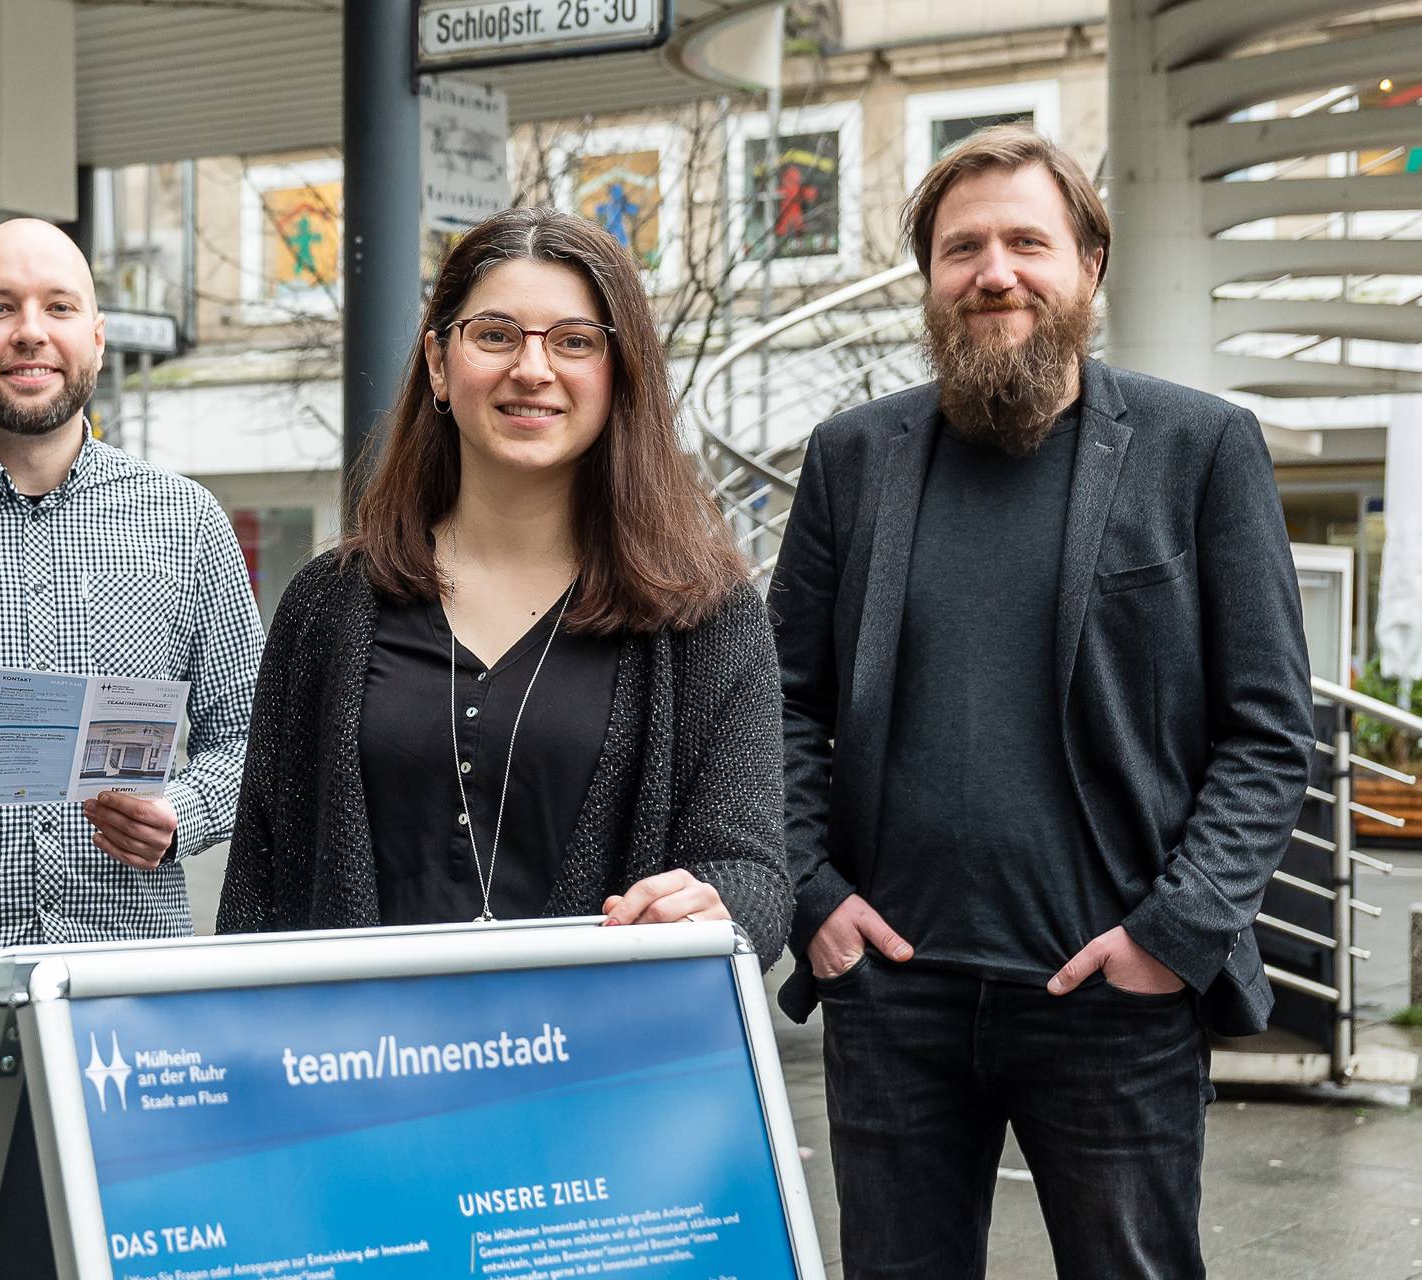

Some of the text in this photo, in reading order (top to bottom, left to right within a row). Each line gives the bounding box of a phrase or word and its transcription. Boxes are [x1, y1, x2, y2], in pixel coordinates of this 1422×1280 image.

[437, 0, 636, 44] Schloßstr. 26-30
[2, 675, 32, 683] KONTAKT
[135, 1048, 201, 1068] Mülheim
[282, 1023, 570, 1085] team/Innenstadt
[138, 1064, 227, 1087] an der Ruhr
[141, 1090, 228, 1110] Stadt am Fluss
[458, 1177, 609, 1216] UNSERE ZIELE
[111, 1222, 227, 1259] DAS TEAM
[476, 1203, 704, 1243] Die Mülheimer Innenstadt ist uns ein großes Anliegen!
[479, 1211, 740, 1258] Gemeinsam mit Ihnen möchten wir die Innenstadt stärken und
[210, 1264, 232, 1278] oder
[233, 1258, 290, 1276] Anregungen
[291, 1257, 307, 1269] zur
[307, 1249, 363, 1266] Entwicklung
[364, 1246, 380, 1259] der
[381, 1240, 429, 1256] Innenstadt
[482, 1258, 532, 1273] entwickeln,
[533, 1253, 562, 1266] sodass
[632, 1240, 650, 1252] und
[576, 1264, 586, 1275] in
[586, 1262, 601, 1274] der
[602, 1256, 648, 1272] Innenstadt
[649, 1250, 694, 1264] verweilen.
